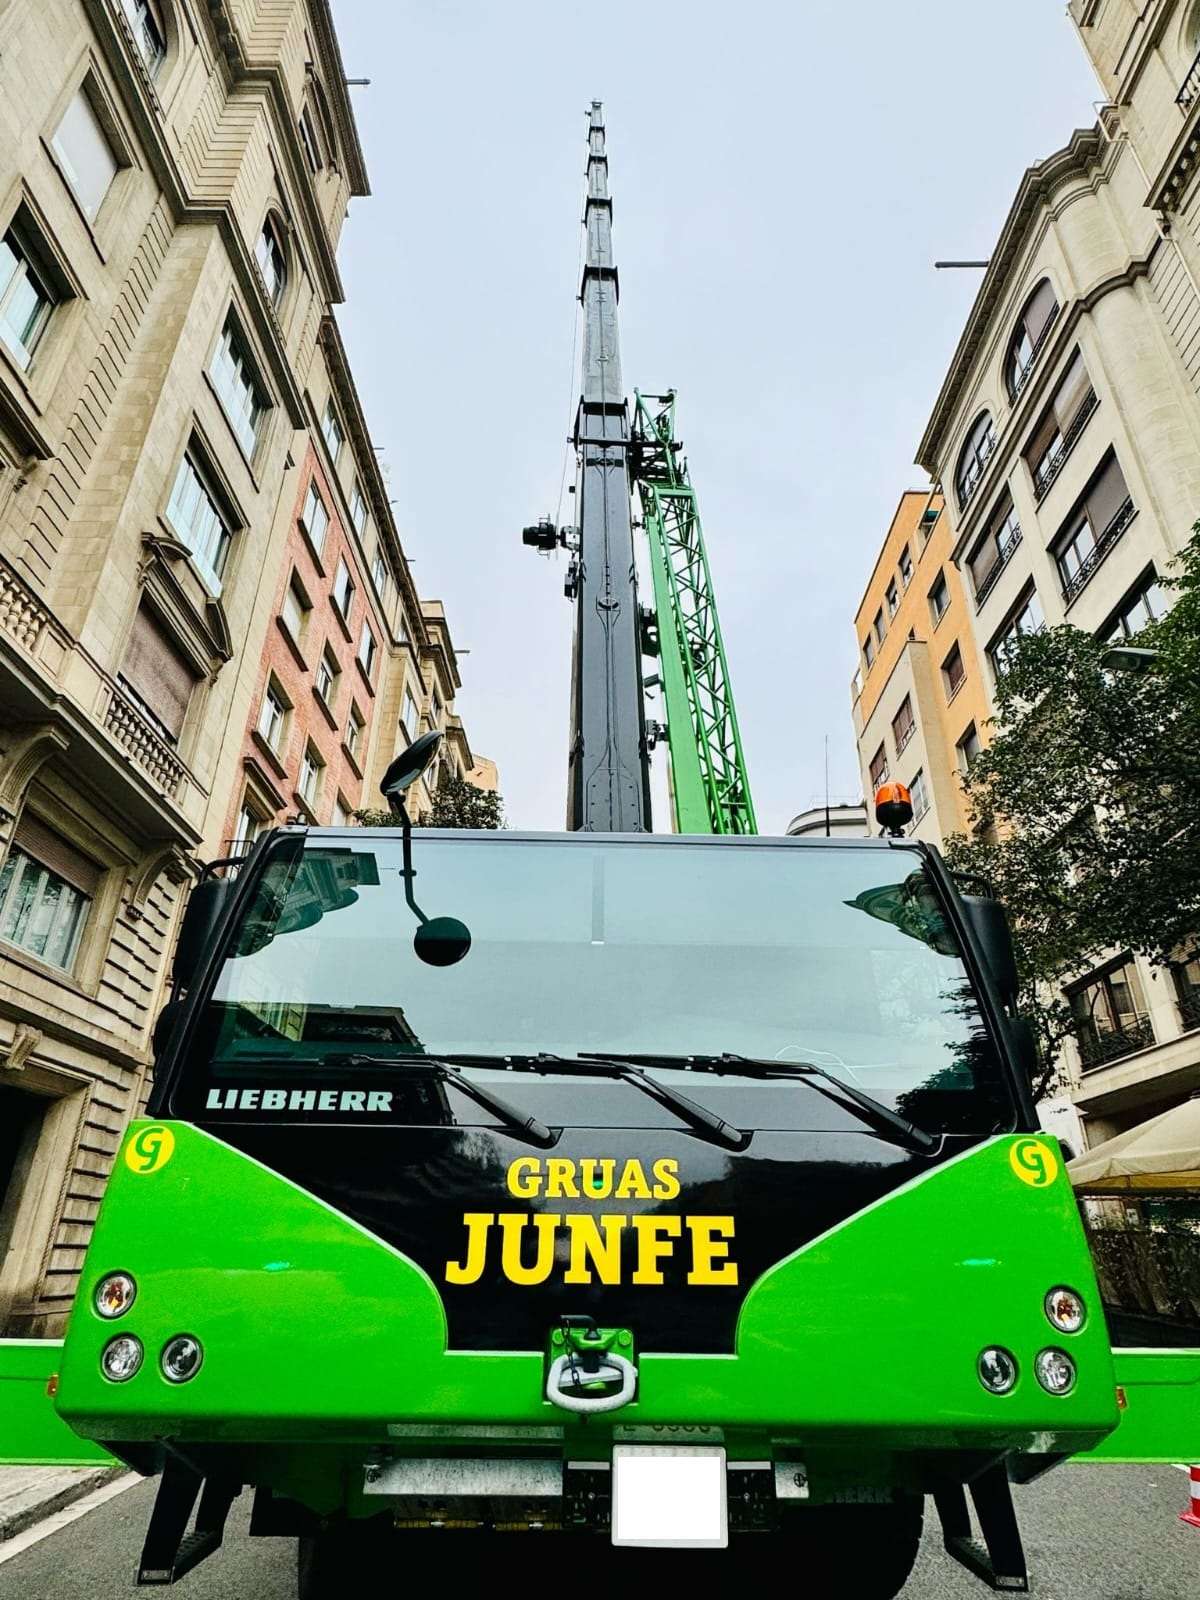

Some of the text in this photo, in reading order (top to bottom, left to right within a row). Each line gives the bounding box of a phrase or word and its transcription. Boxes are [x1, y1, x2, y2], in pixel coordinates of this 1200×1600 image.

[206, 1088, 393, 1112] LIEBHERR
[507, 1157, 681, 1200] GRUAS
[445, 1213, 739, 1285] JUNFE
